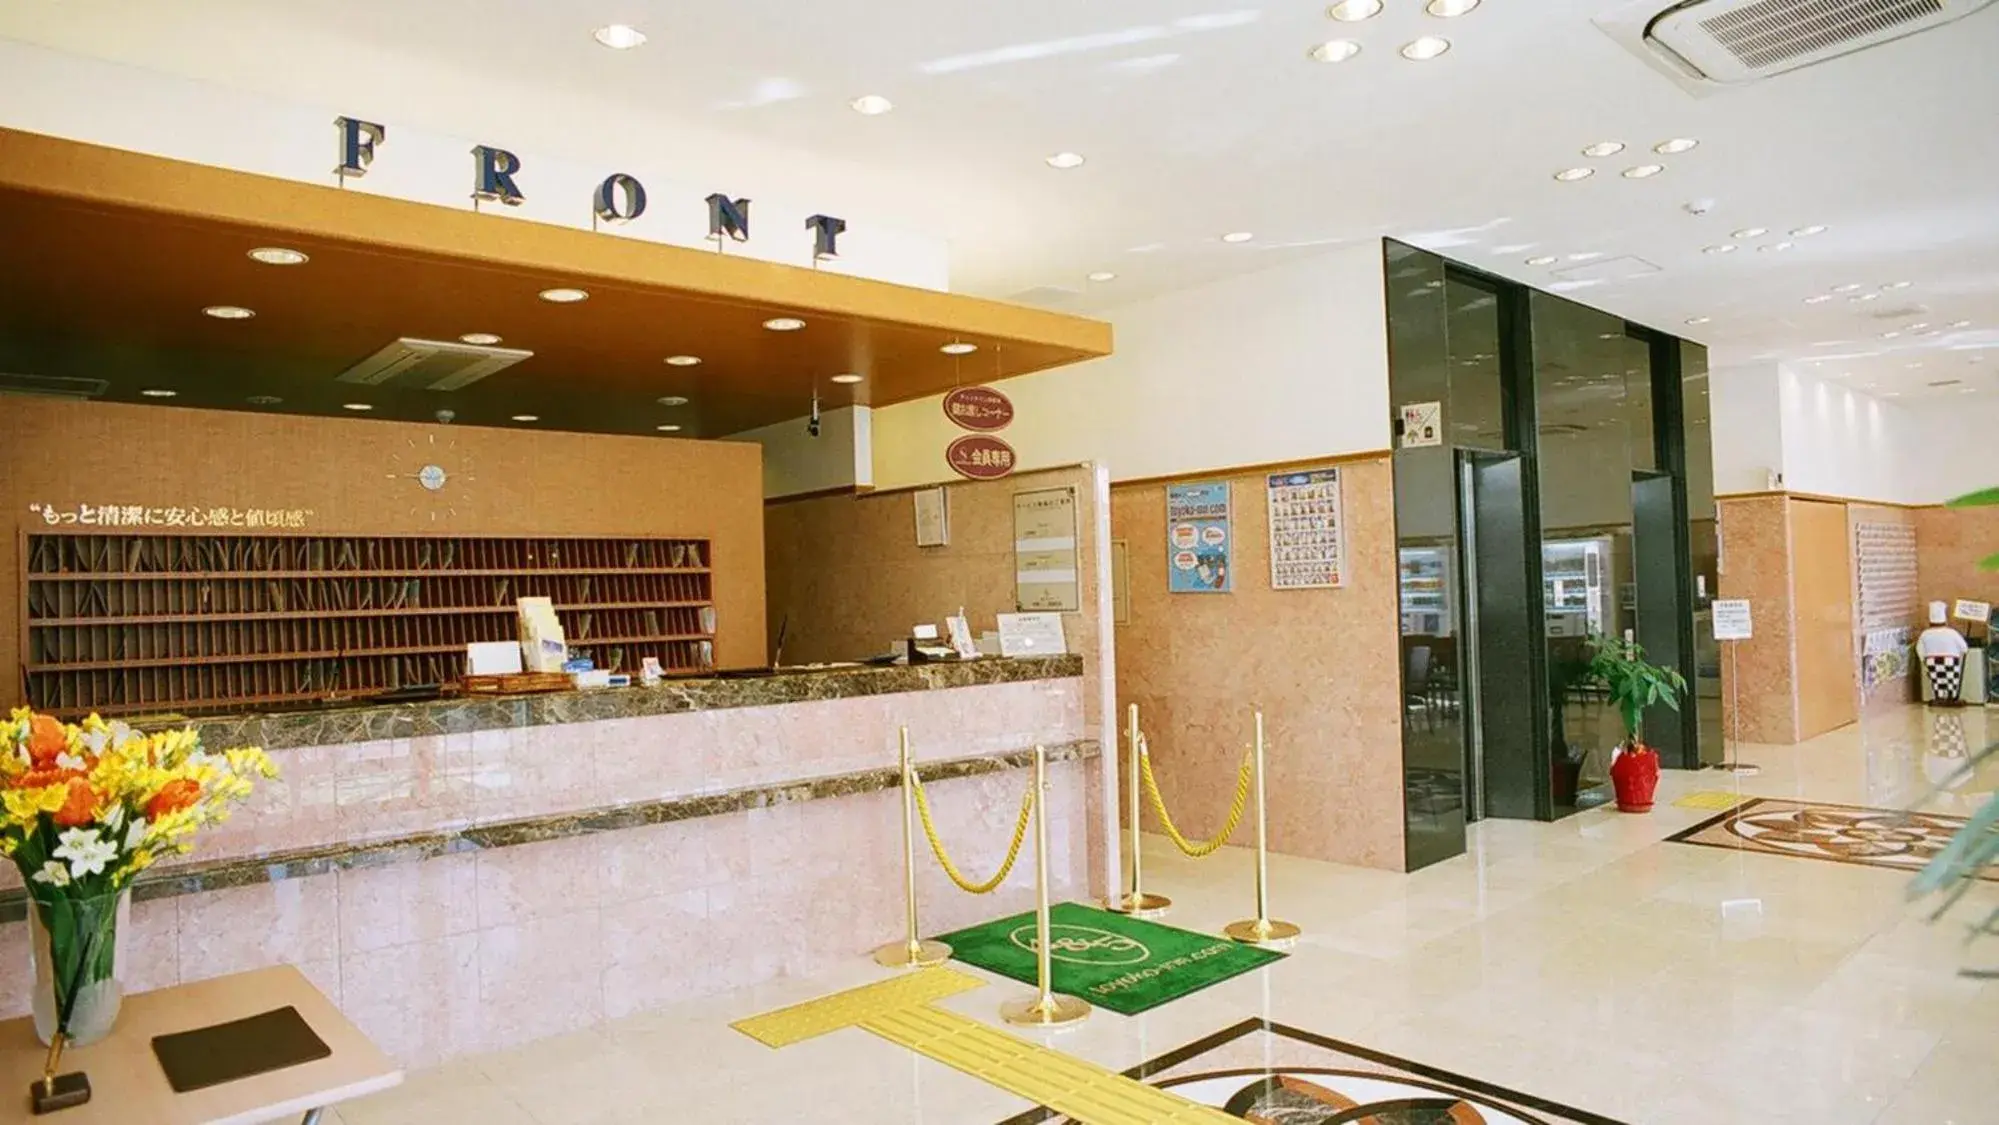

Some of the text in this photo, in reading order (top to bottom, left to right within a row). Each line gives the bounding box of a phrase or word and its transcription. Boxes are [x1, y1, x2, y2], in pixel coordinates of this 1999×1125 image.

[333, 115, 847, 262] FRONT
[971, 447, 1010, 468] 会員専用
